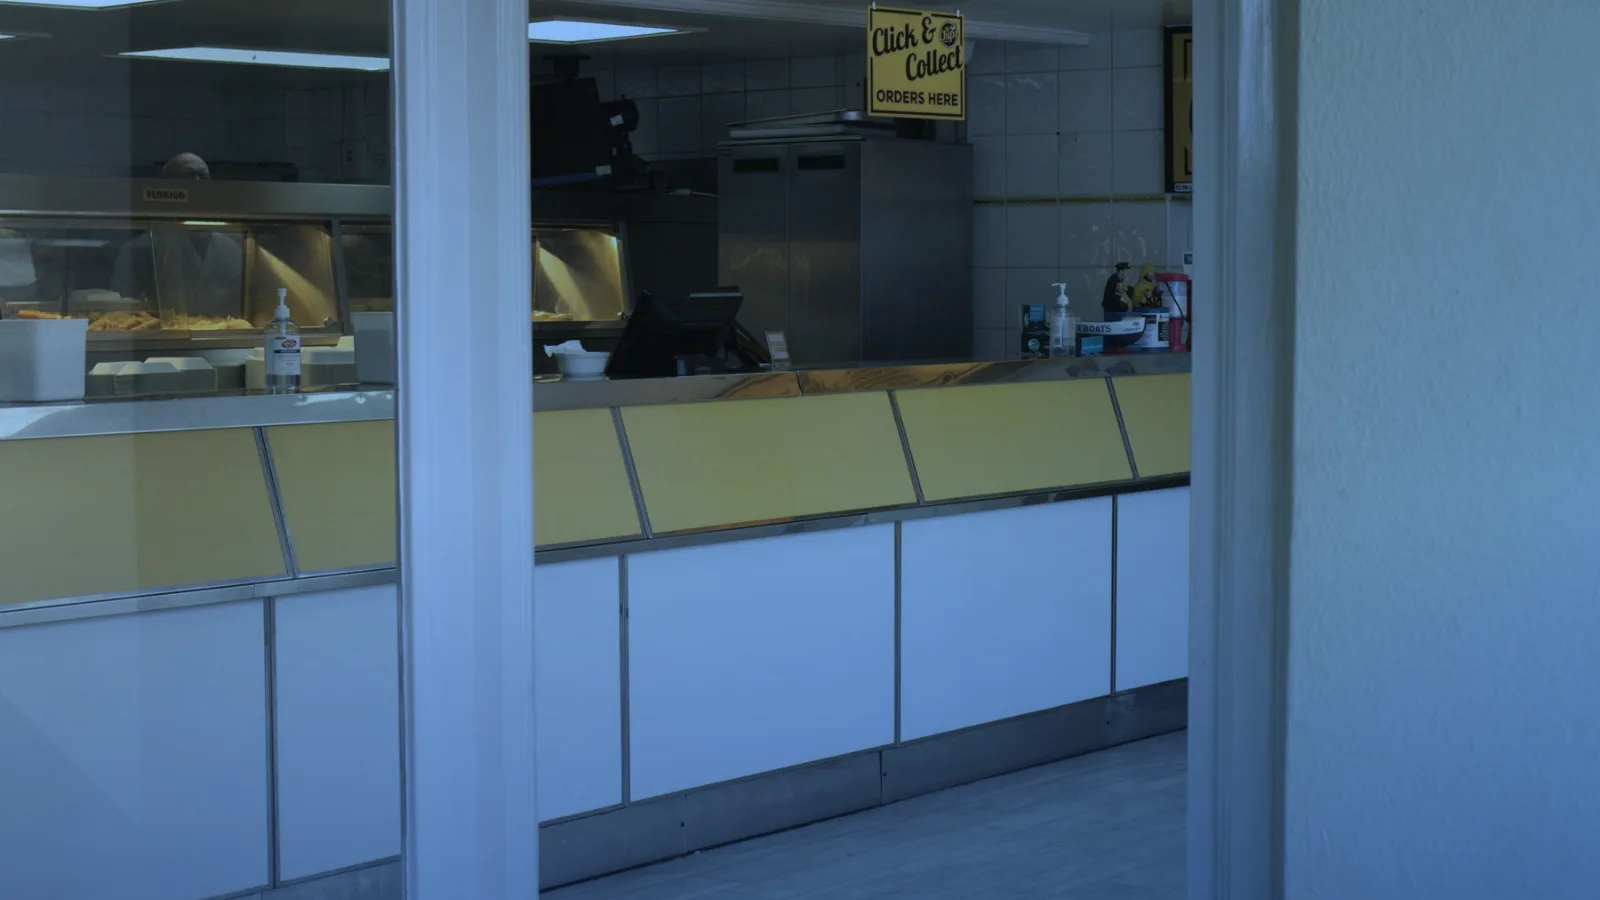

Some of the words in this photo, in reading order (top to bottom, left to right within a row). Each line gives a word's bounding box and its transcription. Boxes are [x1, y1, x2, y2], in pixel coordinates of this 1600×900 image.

[872, 23, 918, 56] Click
[921, 16, 937, 44] &
[906, 45, 963, 81] Collect
[876, 89, 925, 104] ORDERS
[928, 92, 958, 106] HERE
